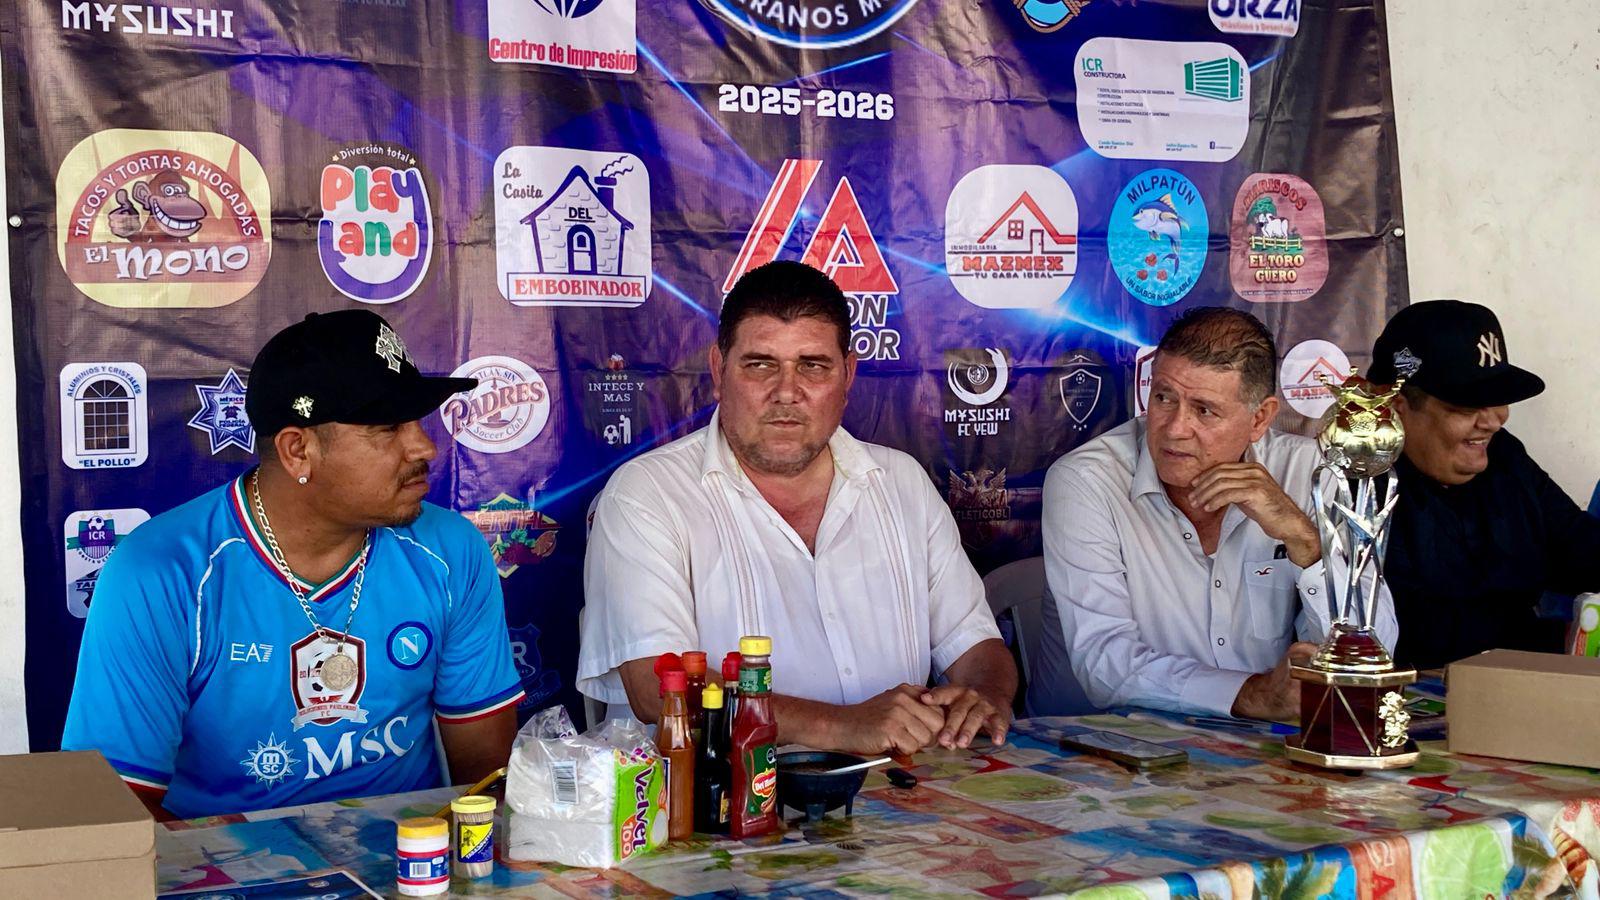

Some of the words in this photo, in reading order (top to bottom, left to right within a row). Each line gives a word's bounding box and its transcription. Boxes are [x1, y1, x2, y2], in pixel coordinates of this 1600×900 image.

[490, 37, 546, 60] Centro
[549, 42, 564, 64] de
[567, 45, 636, 71] Impresión
[1082, 57, 1103, 71] ICR
[1083, 71, 1127, 80] CONSTRUCTORA
[718, 83, 895, 121] 2025-2026
[339, 144, 384, 160] Diversión
[387, 147, 410, 163] total
[502, 162, 522, 179] La
[75, 184, 107, 237] TACOS
[103, 174, 117, 188] Y
[116, 155, 182, 180] TORTAS
[185, 160, 257, 237] AHOGADAS
[503, 183, 544, 199] Casita
[1126, 175, 1196, 206] MILPATÚN
[1243, 178, 1308, 211] MARISCOS
[568, 206, 593, 220] DEL
[962, 256, 1064, 272] MAZMEX
[1248, 254, 1267, 269] EL
[1266, 254, 1305, 269] TORO
[1254, 267, 1298, 284] GÜERO
[514, 278, 643, 298] EMBOBINADOR
[66, 366, 100, 398] ALUMINIOS
[107, 366, 142, 395] CRISTALES
[588, 382, 634, 391] INTECE
[636, 382, 645, 391] Y
[603, 393, 631, 402] MAS
[443, 382, 546, 438] PADRES
[473, 426, 504, 439] Soccer
[505, 416, 525, 436] Club
[957, 423, 971, 436] FC
[973, 422, 998, 436] YEW
[88, 530, 106, 541] ICR
[399, 634, 420, 660] N
[302, 715, 415, 780] MSC
[632, 766, 654, 852] Velvet
[622, 822, 634, 856] 100
